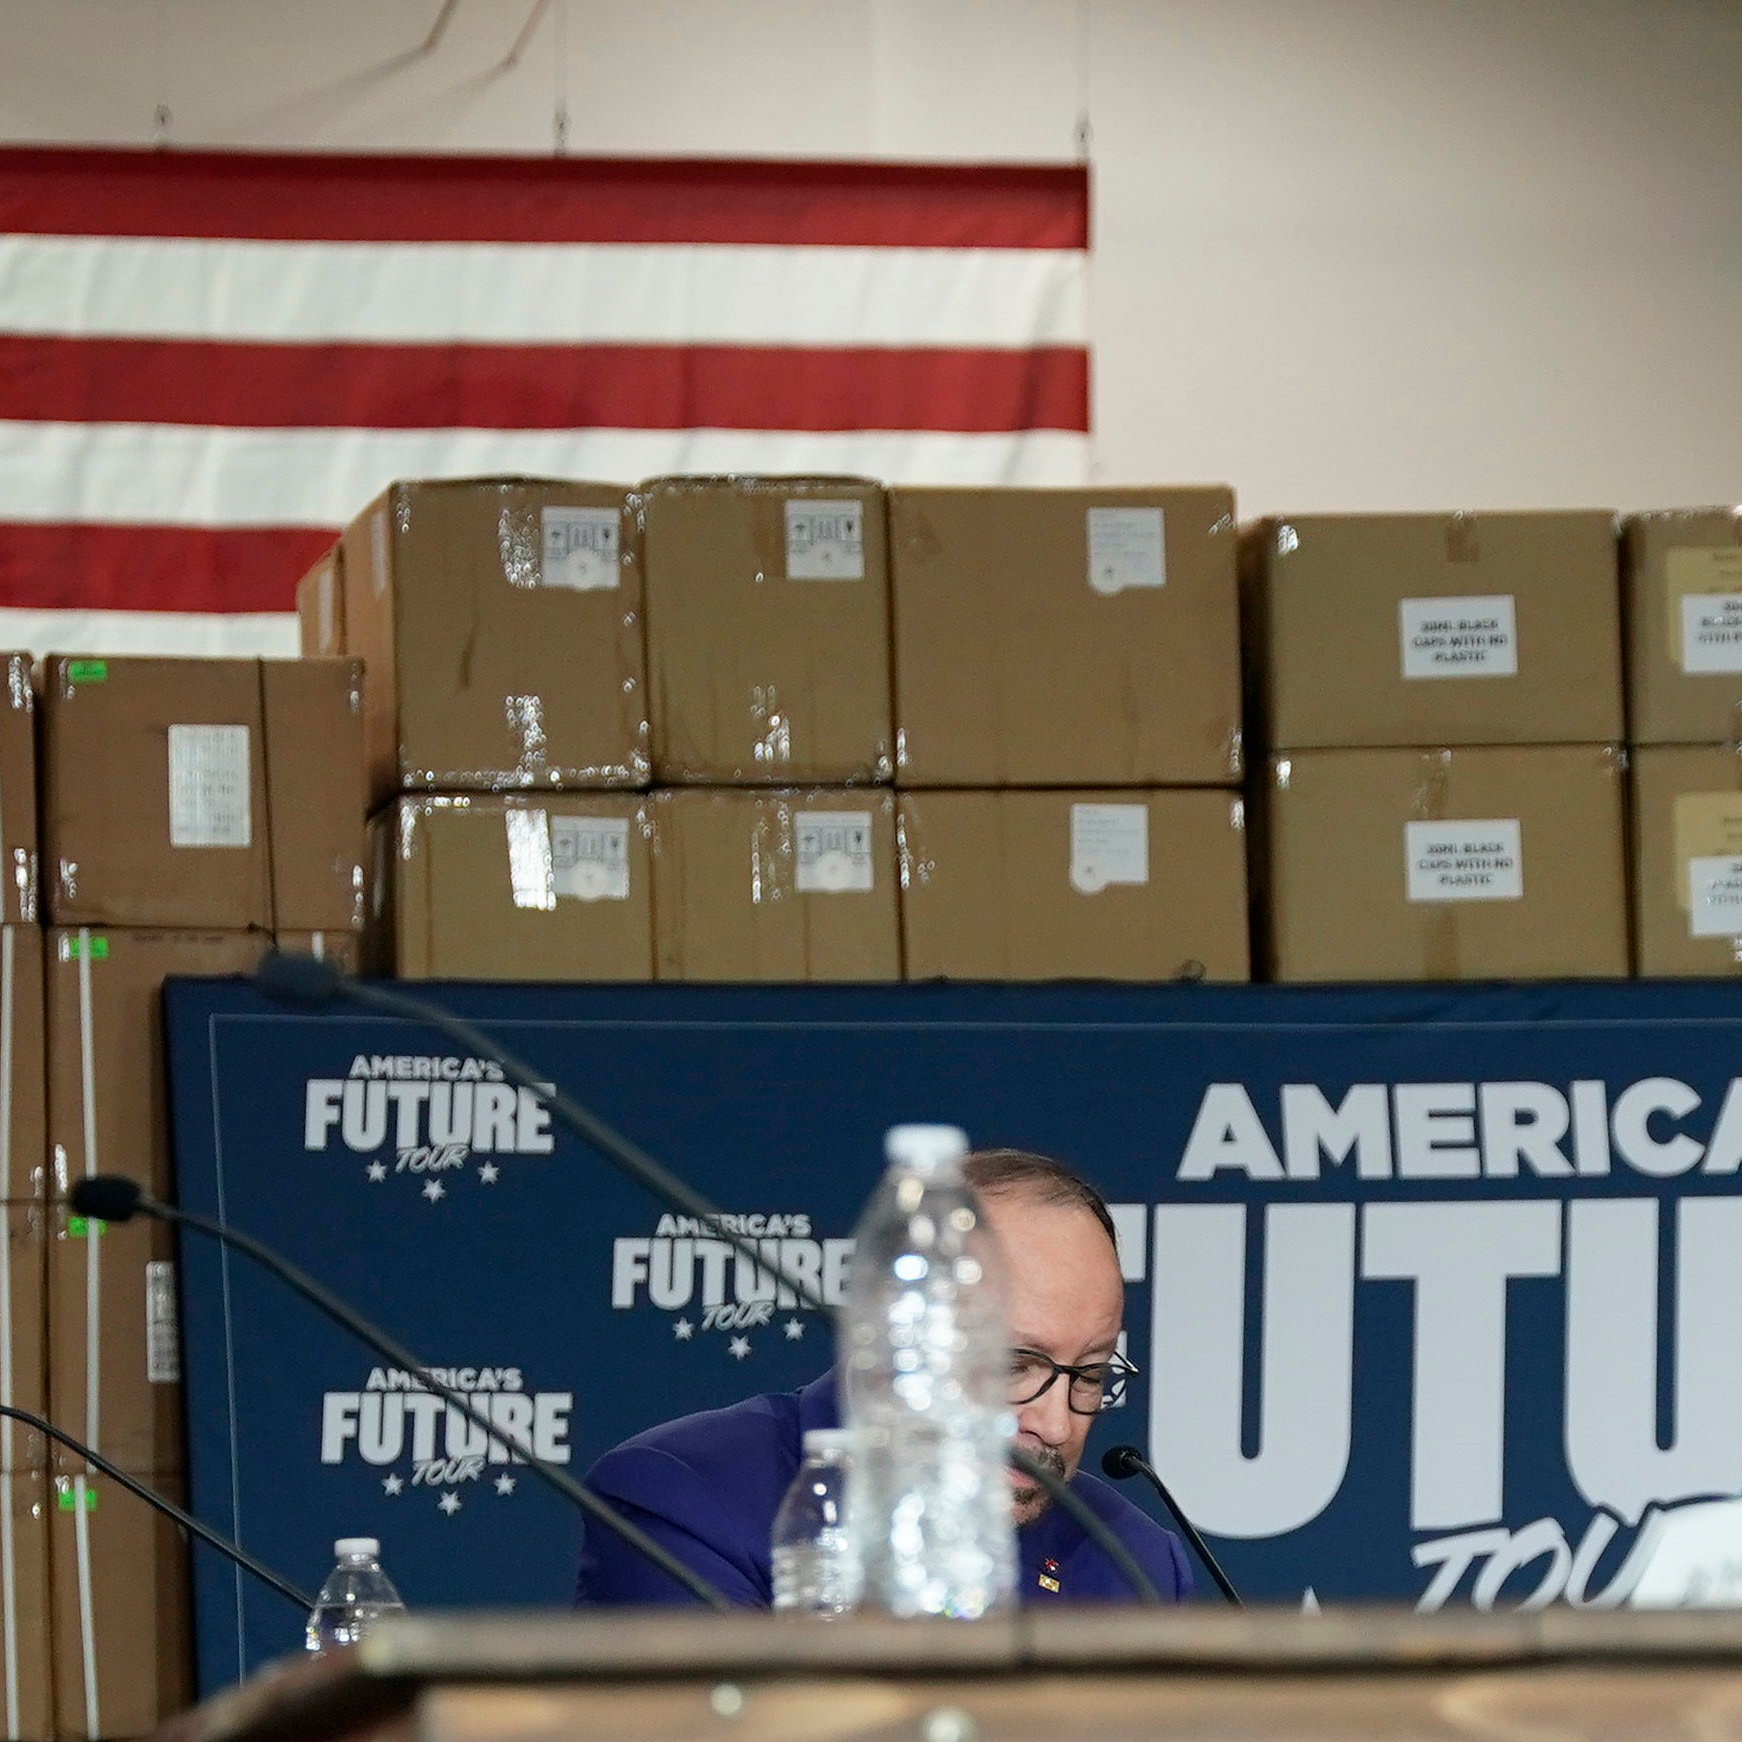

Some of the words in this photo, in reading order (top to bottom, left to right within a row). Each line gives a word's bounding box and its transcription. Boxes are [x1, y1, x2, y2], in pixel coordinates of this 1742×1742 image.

[349, 1054, 506, 1082] AMERICA'S
[305, 1078, 557, 1155] FUTURE
[394, 1143, 470, 1174] TOUR
[656, 1213, 812, 1238] AMERICA'S
[611, 1237, 858, 1311] FUTURE
[701, 1300, 776, 1331] TOUR
[365, 1366, 524, 1393] AMERICA'S
[320, 1391, 574, 1466] FUTURE
[410, 1454, 487, 1488] TOUR
[1410, 1505, 1666, 1613] TOU
